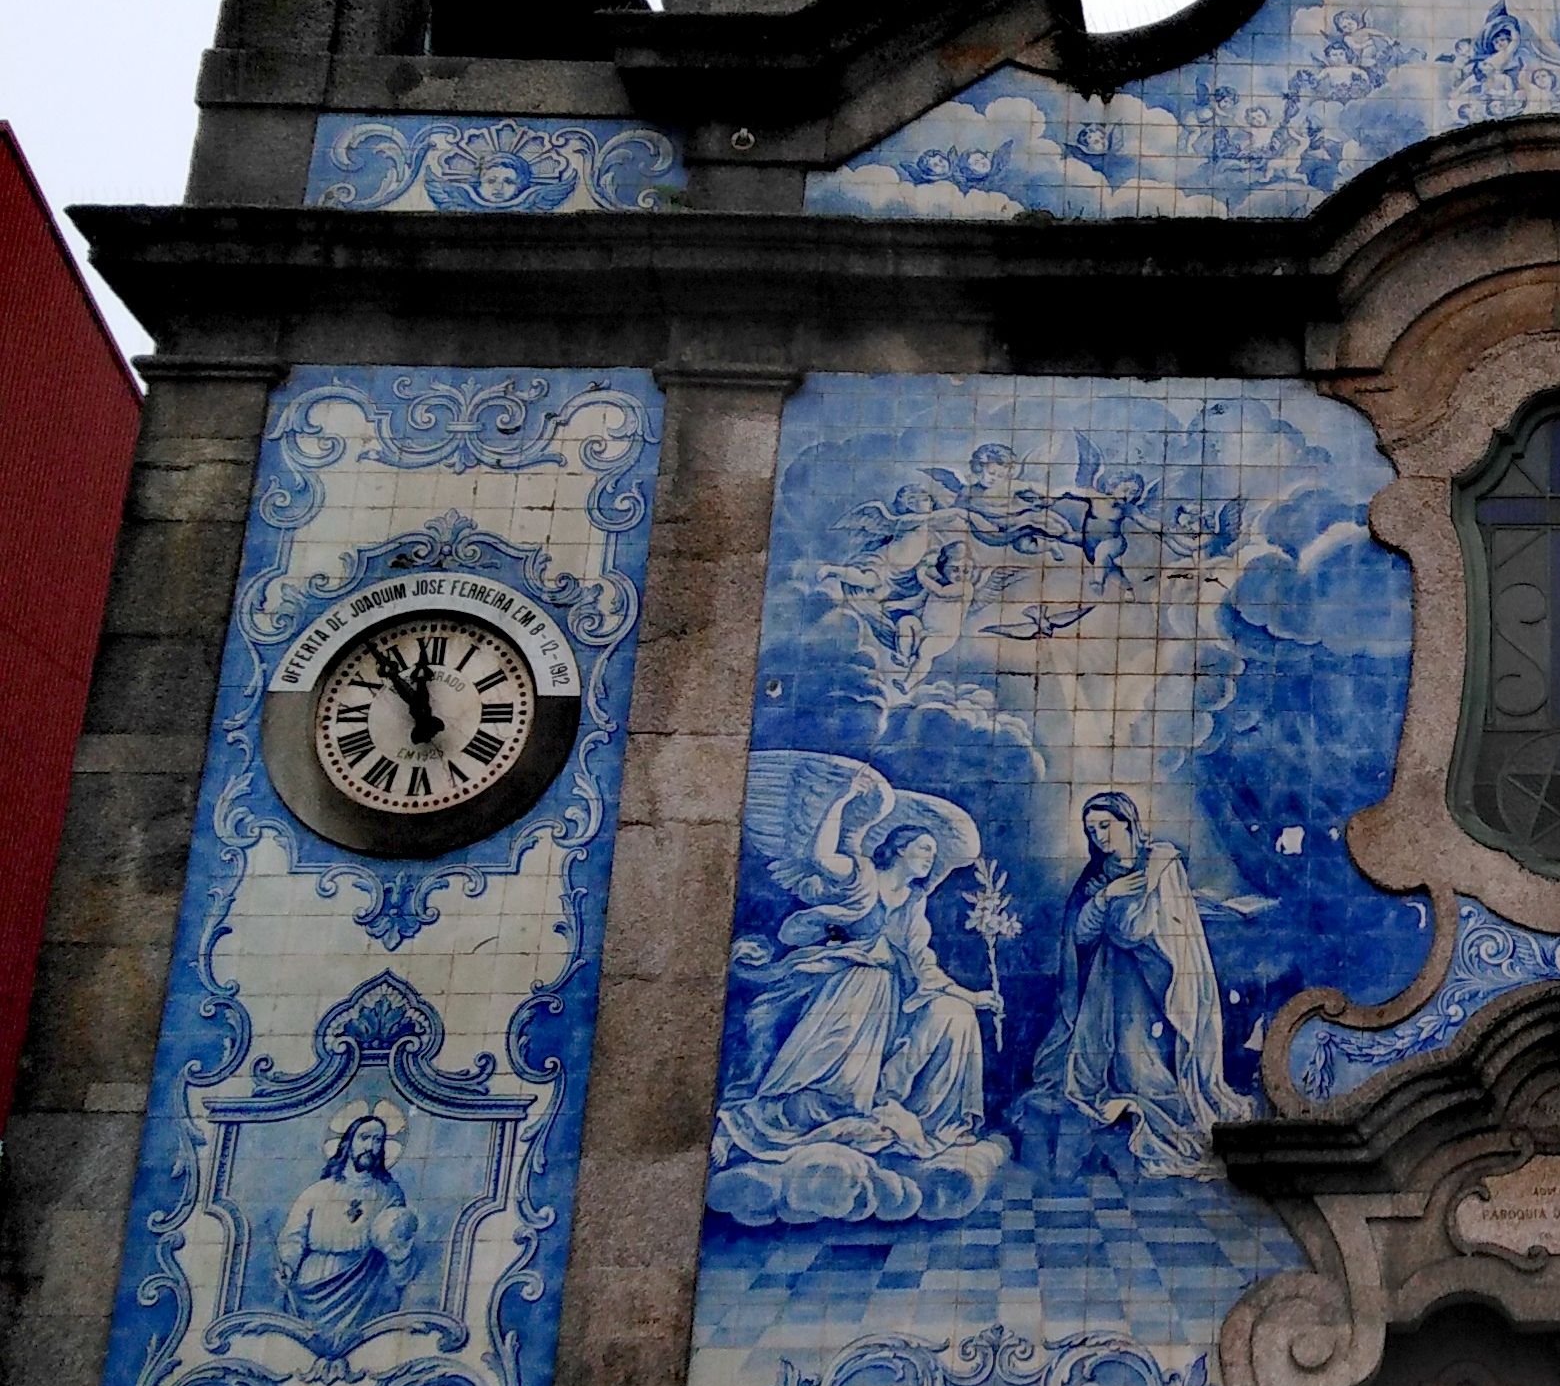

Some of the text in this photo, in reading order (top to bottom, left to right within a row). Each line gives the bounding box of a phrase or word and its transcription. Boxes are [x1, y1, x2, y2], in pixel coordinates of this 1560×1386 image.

[281, 629, 330, 684] OFFERTA
[326, 611, 348, 632] DE
[350, 583, 407, 618] JOAQUIM
[412, 579, 446, 596] JOSE
[451, 580, 514, 613] FERREIRA
[512, 605, 536, 628] EM
